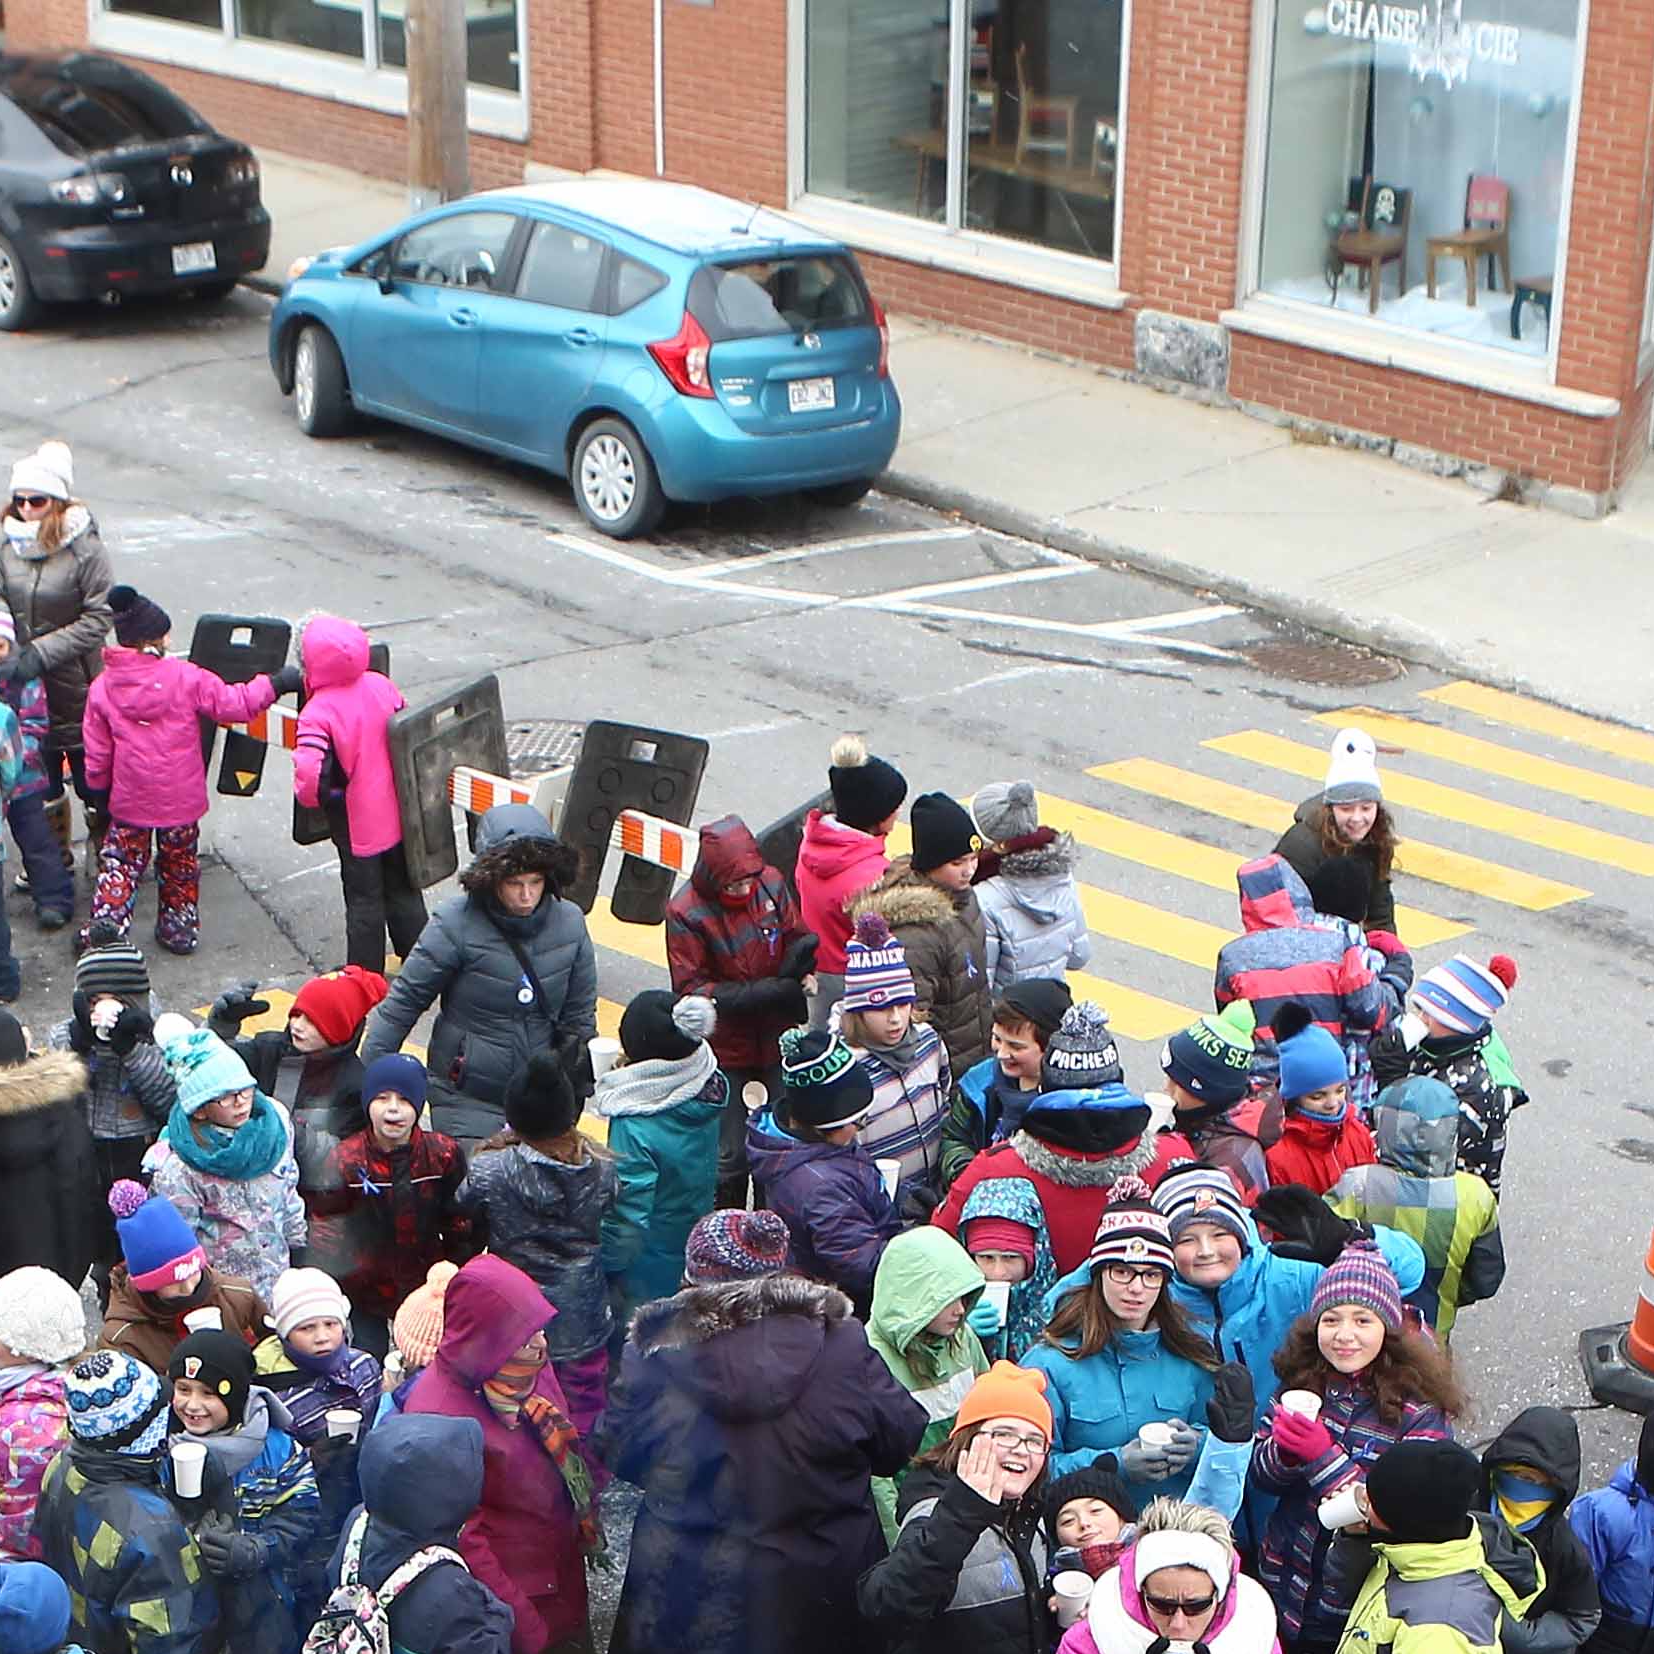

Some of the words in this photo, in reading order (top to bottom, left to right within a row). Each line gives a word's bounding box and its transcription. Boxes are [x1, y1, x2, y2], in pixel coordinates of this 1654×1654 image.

[1476, 23, 1520, 64] CIE
[847, 947, 905, 968] ANADIEN
[1225, 1047, 1252, 1070] SEA
